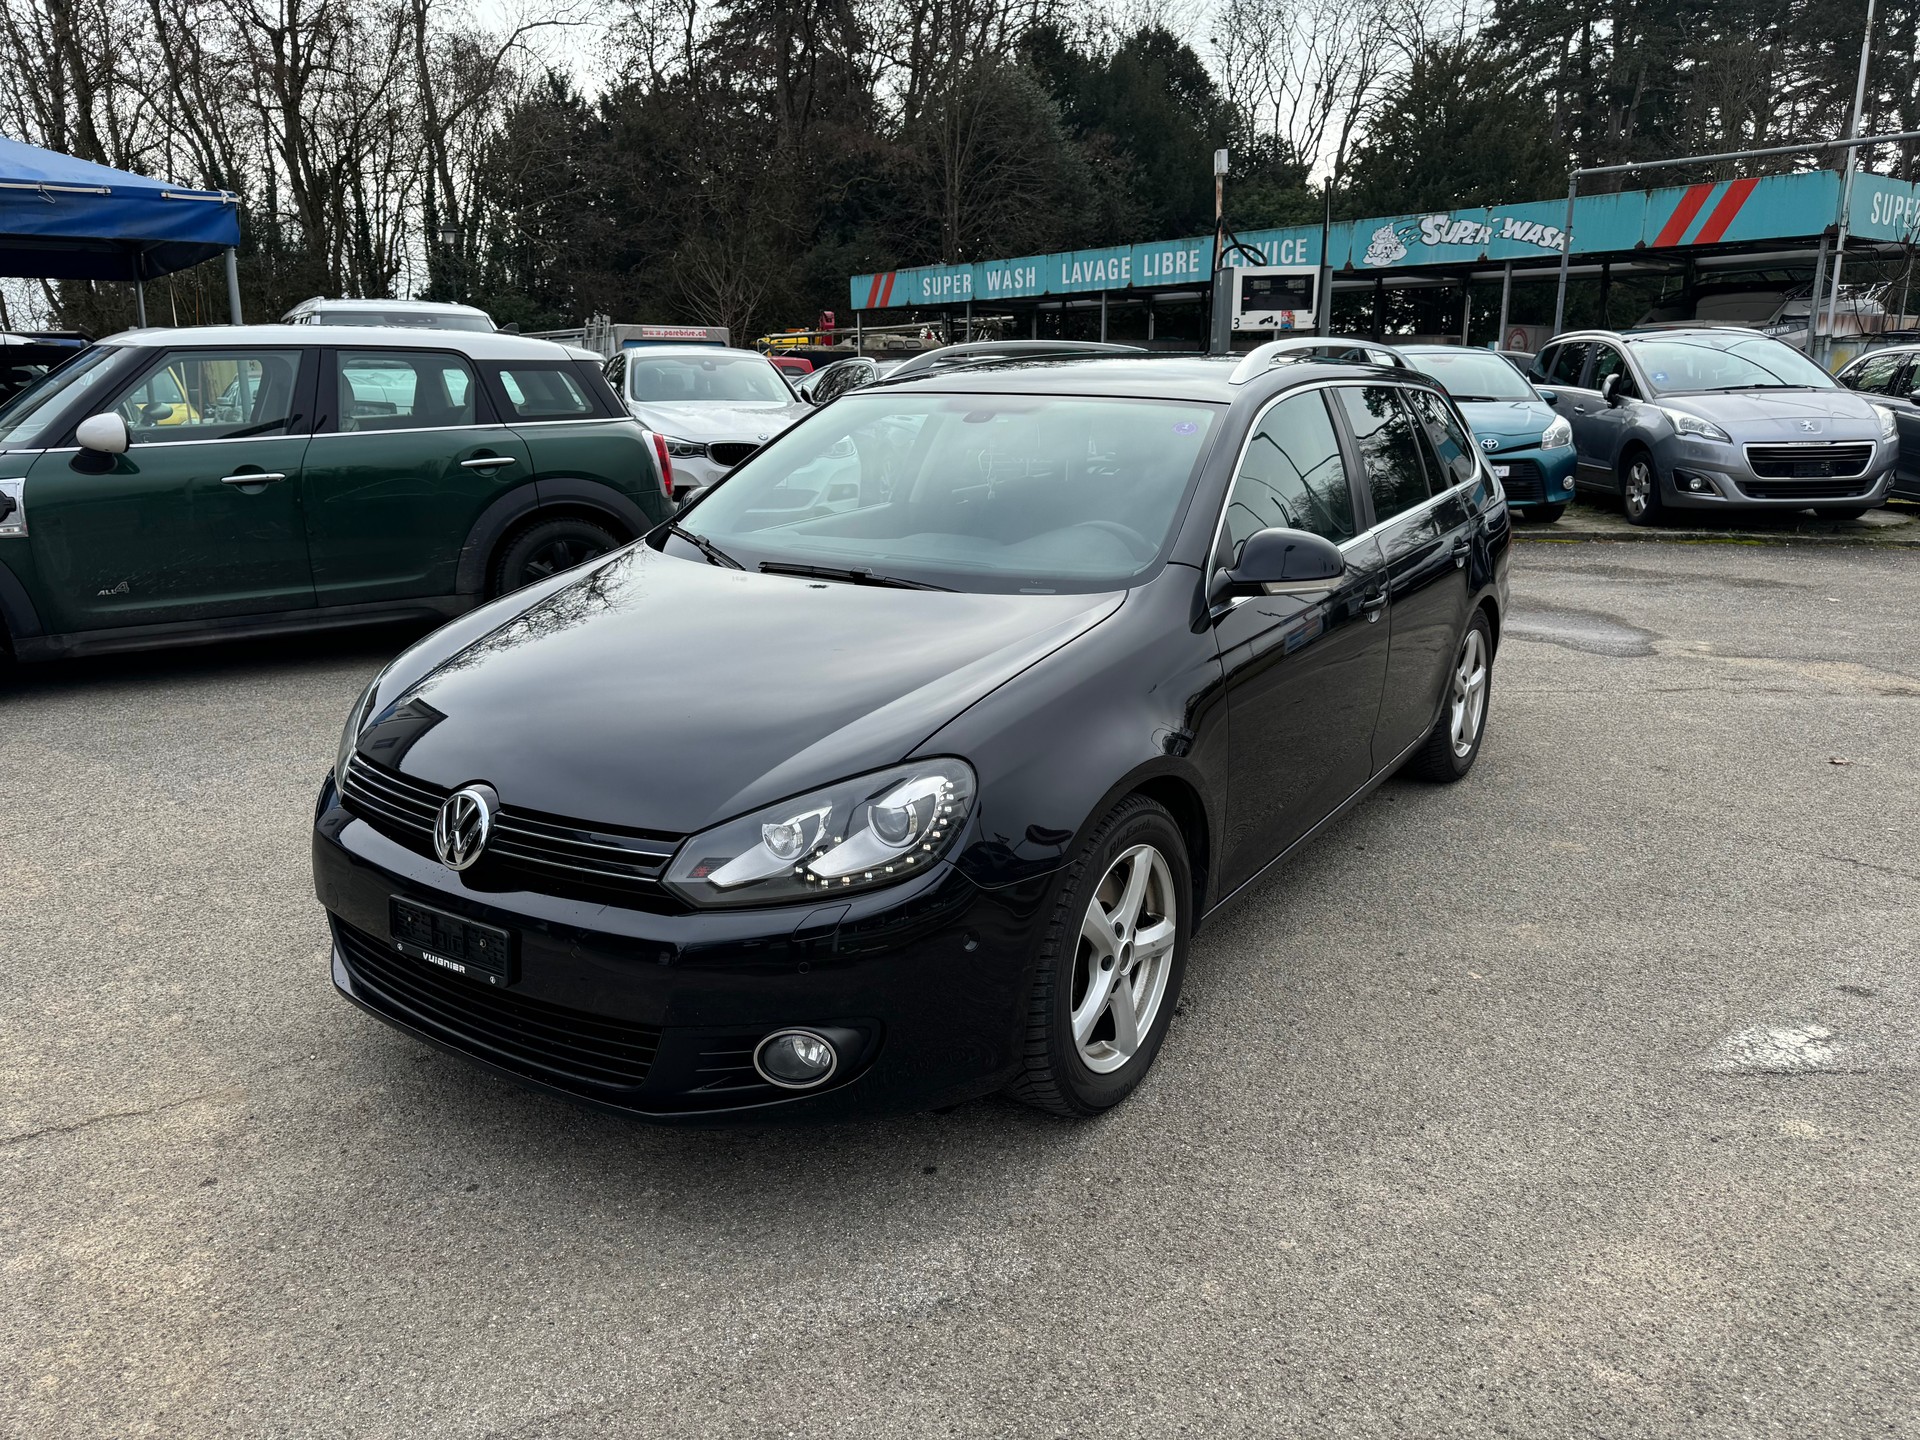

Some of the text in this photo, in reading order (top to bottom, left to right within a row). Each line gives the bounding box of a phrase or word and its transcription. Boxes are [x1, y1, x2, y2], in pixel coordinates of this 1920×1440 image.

[1420, 214, 1575, 251] SUPER WASH
[922, 273, 972, 297] SUPER
[986, 266, 1036, 291] WASH
[1061, 256, 1131, 285] LAVAGE
[1143, 249, 1200, 277] LIBRE
[1232, 317, 1240, 330] 3
[97, 581, 130, 596] ALL4
